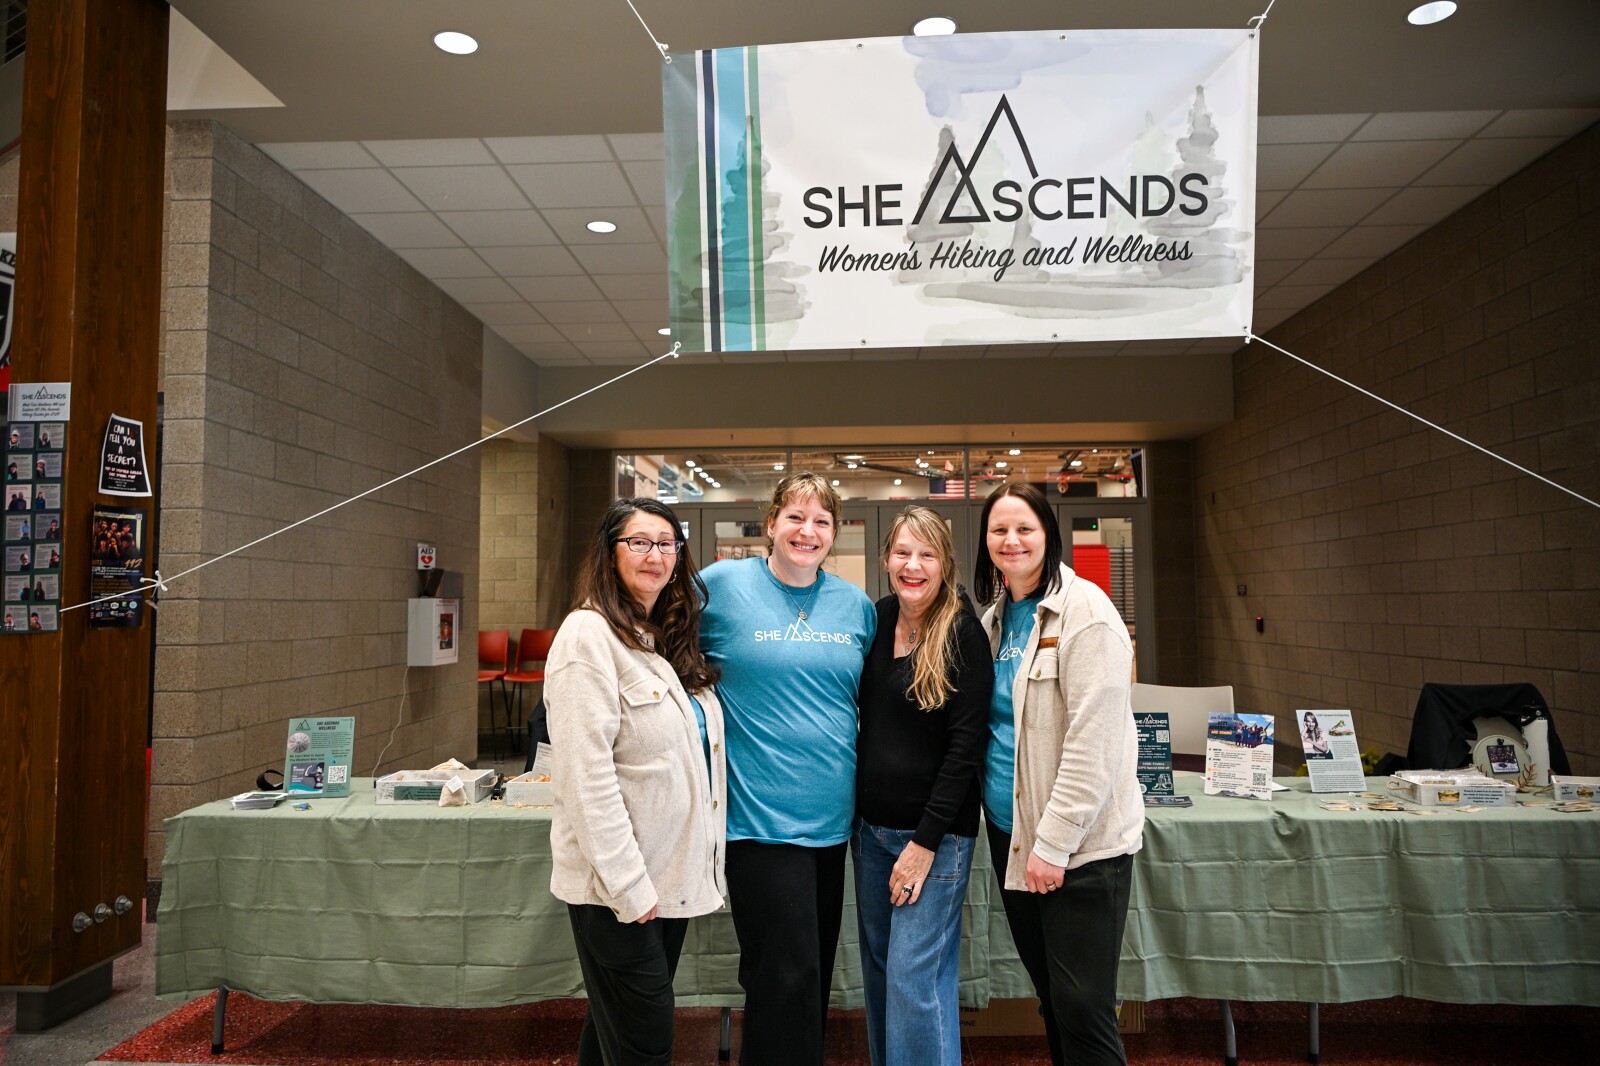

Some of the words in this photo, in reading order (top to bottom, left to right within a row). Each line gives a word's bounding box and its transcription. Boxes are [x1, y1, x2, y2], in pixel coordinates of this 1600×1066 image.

[803, 184, 903, 229] SHE
[911, 94, 1209, 224] ASCENDS
[819, 244, 921, 274] Women's
[929, 240, 1015, 282] Hiking
[1022, 237, 1075, 266] and
[1082, 236, 1193, 265] Wellness
[114, 425, 124, 434] CAN
[127, 427, 130, 435] I
[109, 434, 120, 443] TELL
[122, 436, 135, 446] YOU
[118, 445, 123, 454] A
[108, 454, 136, 467] SECRET?
[754, 630, 782, 642] SHE
[783, 617, 852, 645] ASCENDS
